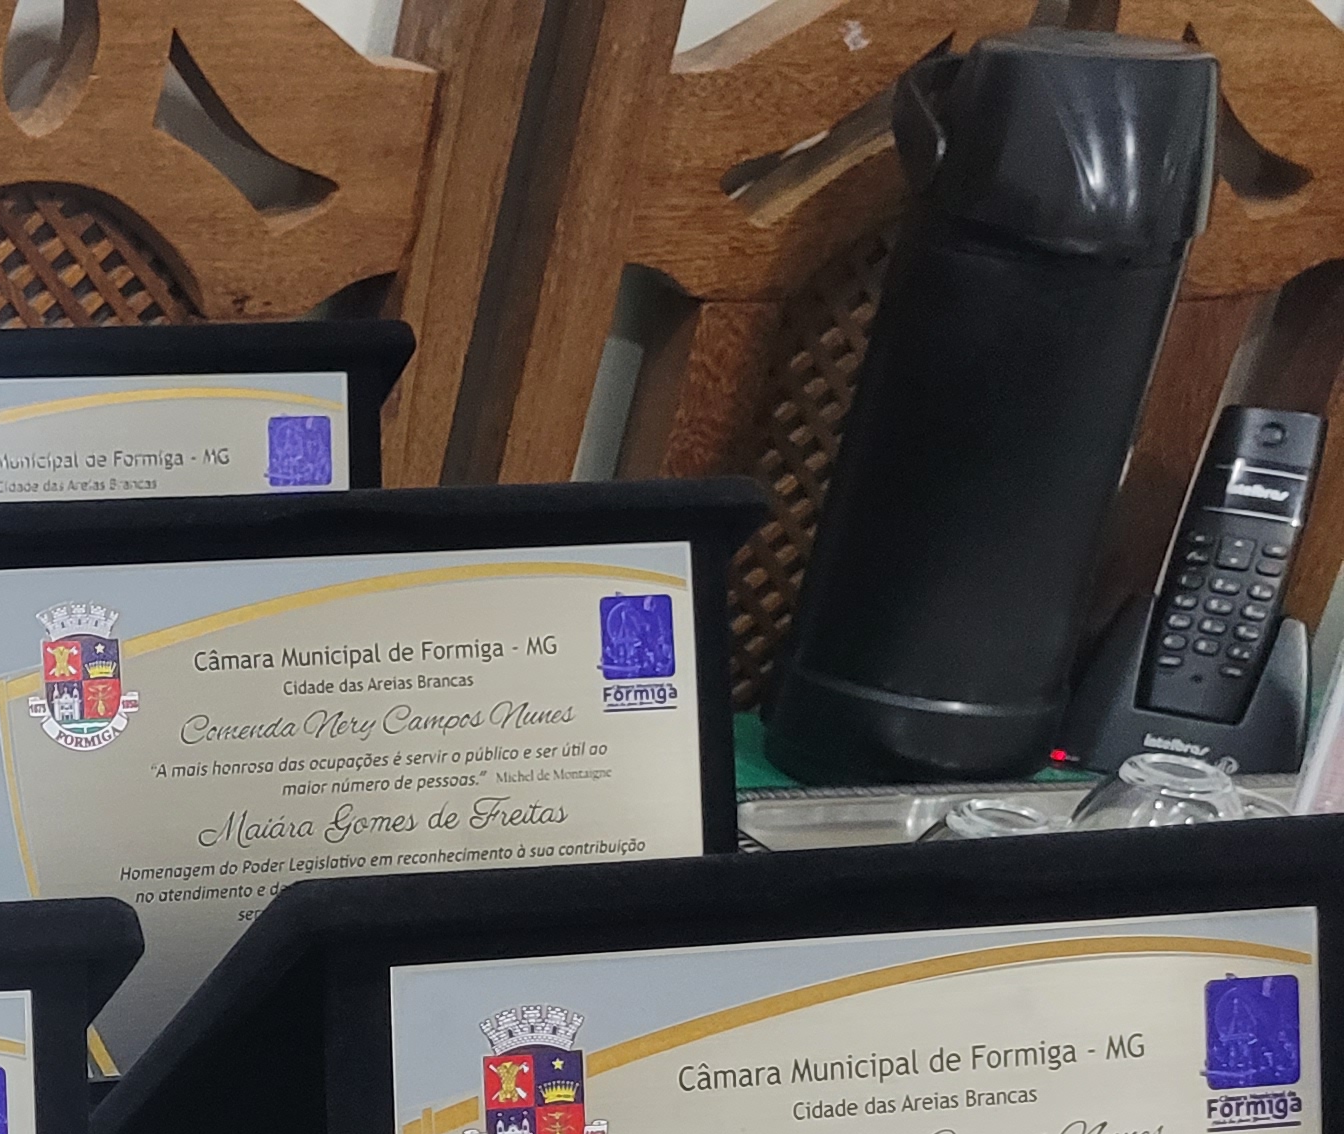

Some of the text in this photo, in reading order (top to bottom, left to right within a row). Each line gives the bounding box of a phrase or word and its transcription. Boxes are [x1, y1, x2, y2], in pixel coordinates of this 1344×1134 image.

[85, 454, 108, 469] de
[113, 449, 184, 471] Formiga
[203, 447, 231, 466] MG
[197, 795, 568, 849] Maiára Gomes de Freitas
[678, 1062, 782, 1092] Câmara
[791, 1049, 920, 1084] Municipal
[928, 1047, 962, 1074] de
[971, 1040, 1077, 1071] Formiga
[1105, 1032, 1145, 1060] MG
[792, 1088, 1038, 1121] Cidade das Areias Brancas
[1206, 1096, 1303, 1120] Formiga
